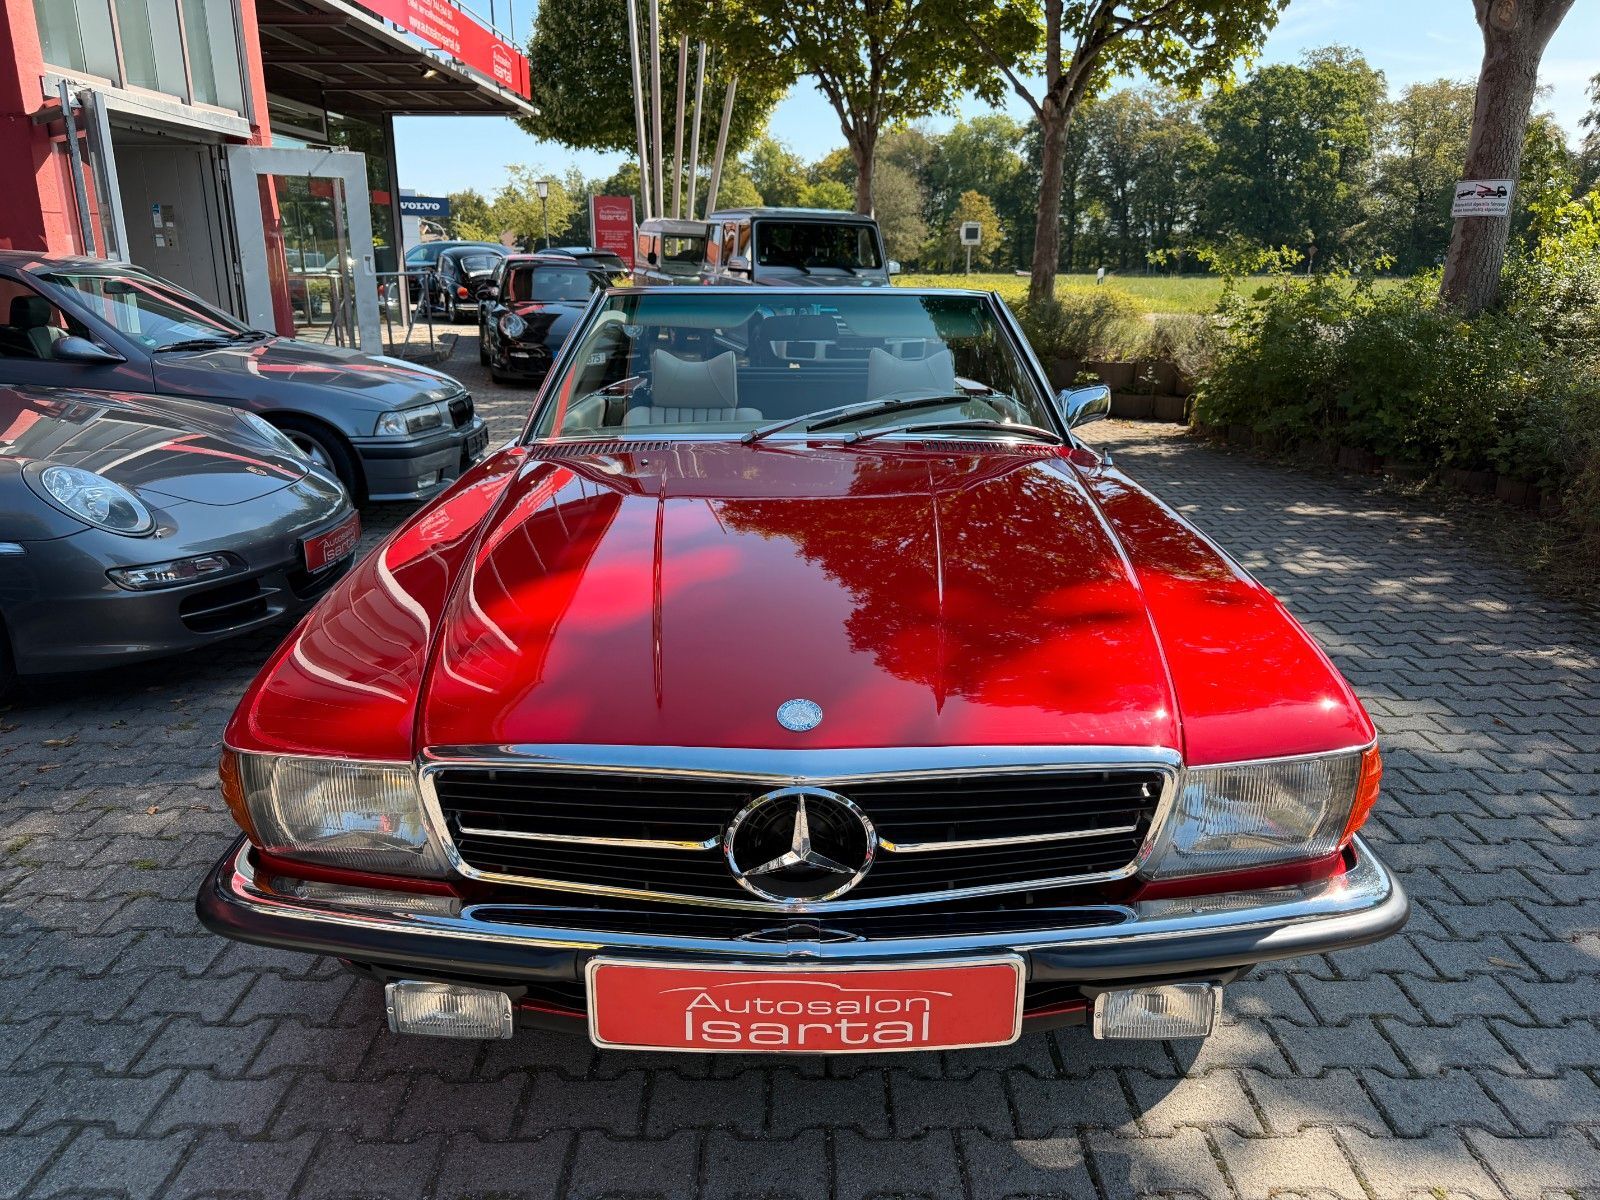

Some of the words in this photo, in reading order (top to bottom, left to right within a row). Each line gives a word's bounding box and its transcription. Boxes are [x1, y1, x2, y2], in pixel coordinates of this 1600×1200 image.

[400, 201, 441, 211] VOLVO
[685, 992, 931, 1016] Autosalon
[685, 1010, 930, 1045] Isartal
